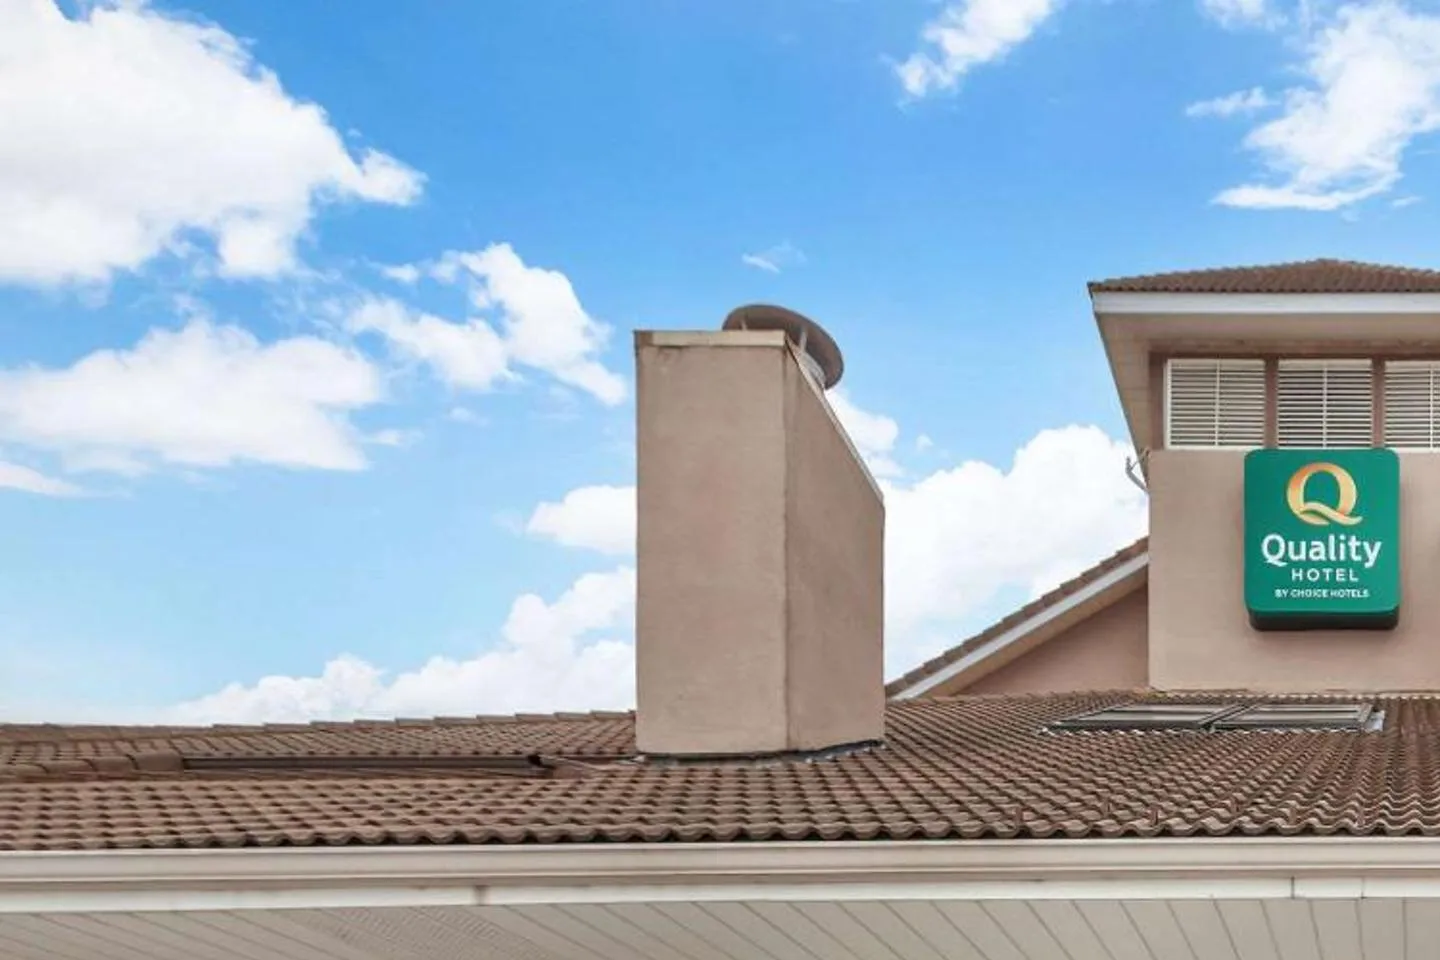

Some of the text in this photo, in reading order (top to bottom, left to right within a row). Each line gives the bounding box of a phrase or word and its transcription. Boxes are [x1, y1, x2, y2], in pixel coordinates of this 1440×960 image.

[1286, 462, 1363, 526] Q
[1261, 533, 1382, 568] Quality
[1291, 568, 1359, 582] HOTEL
[1274, 588, 1370, 598] BY CHOICE HOTELS
